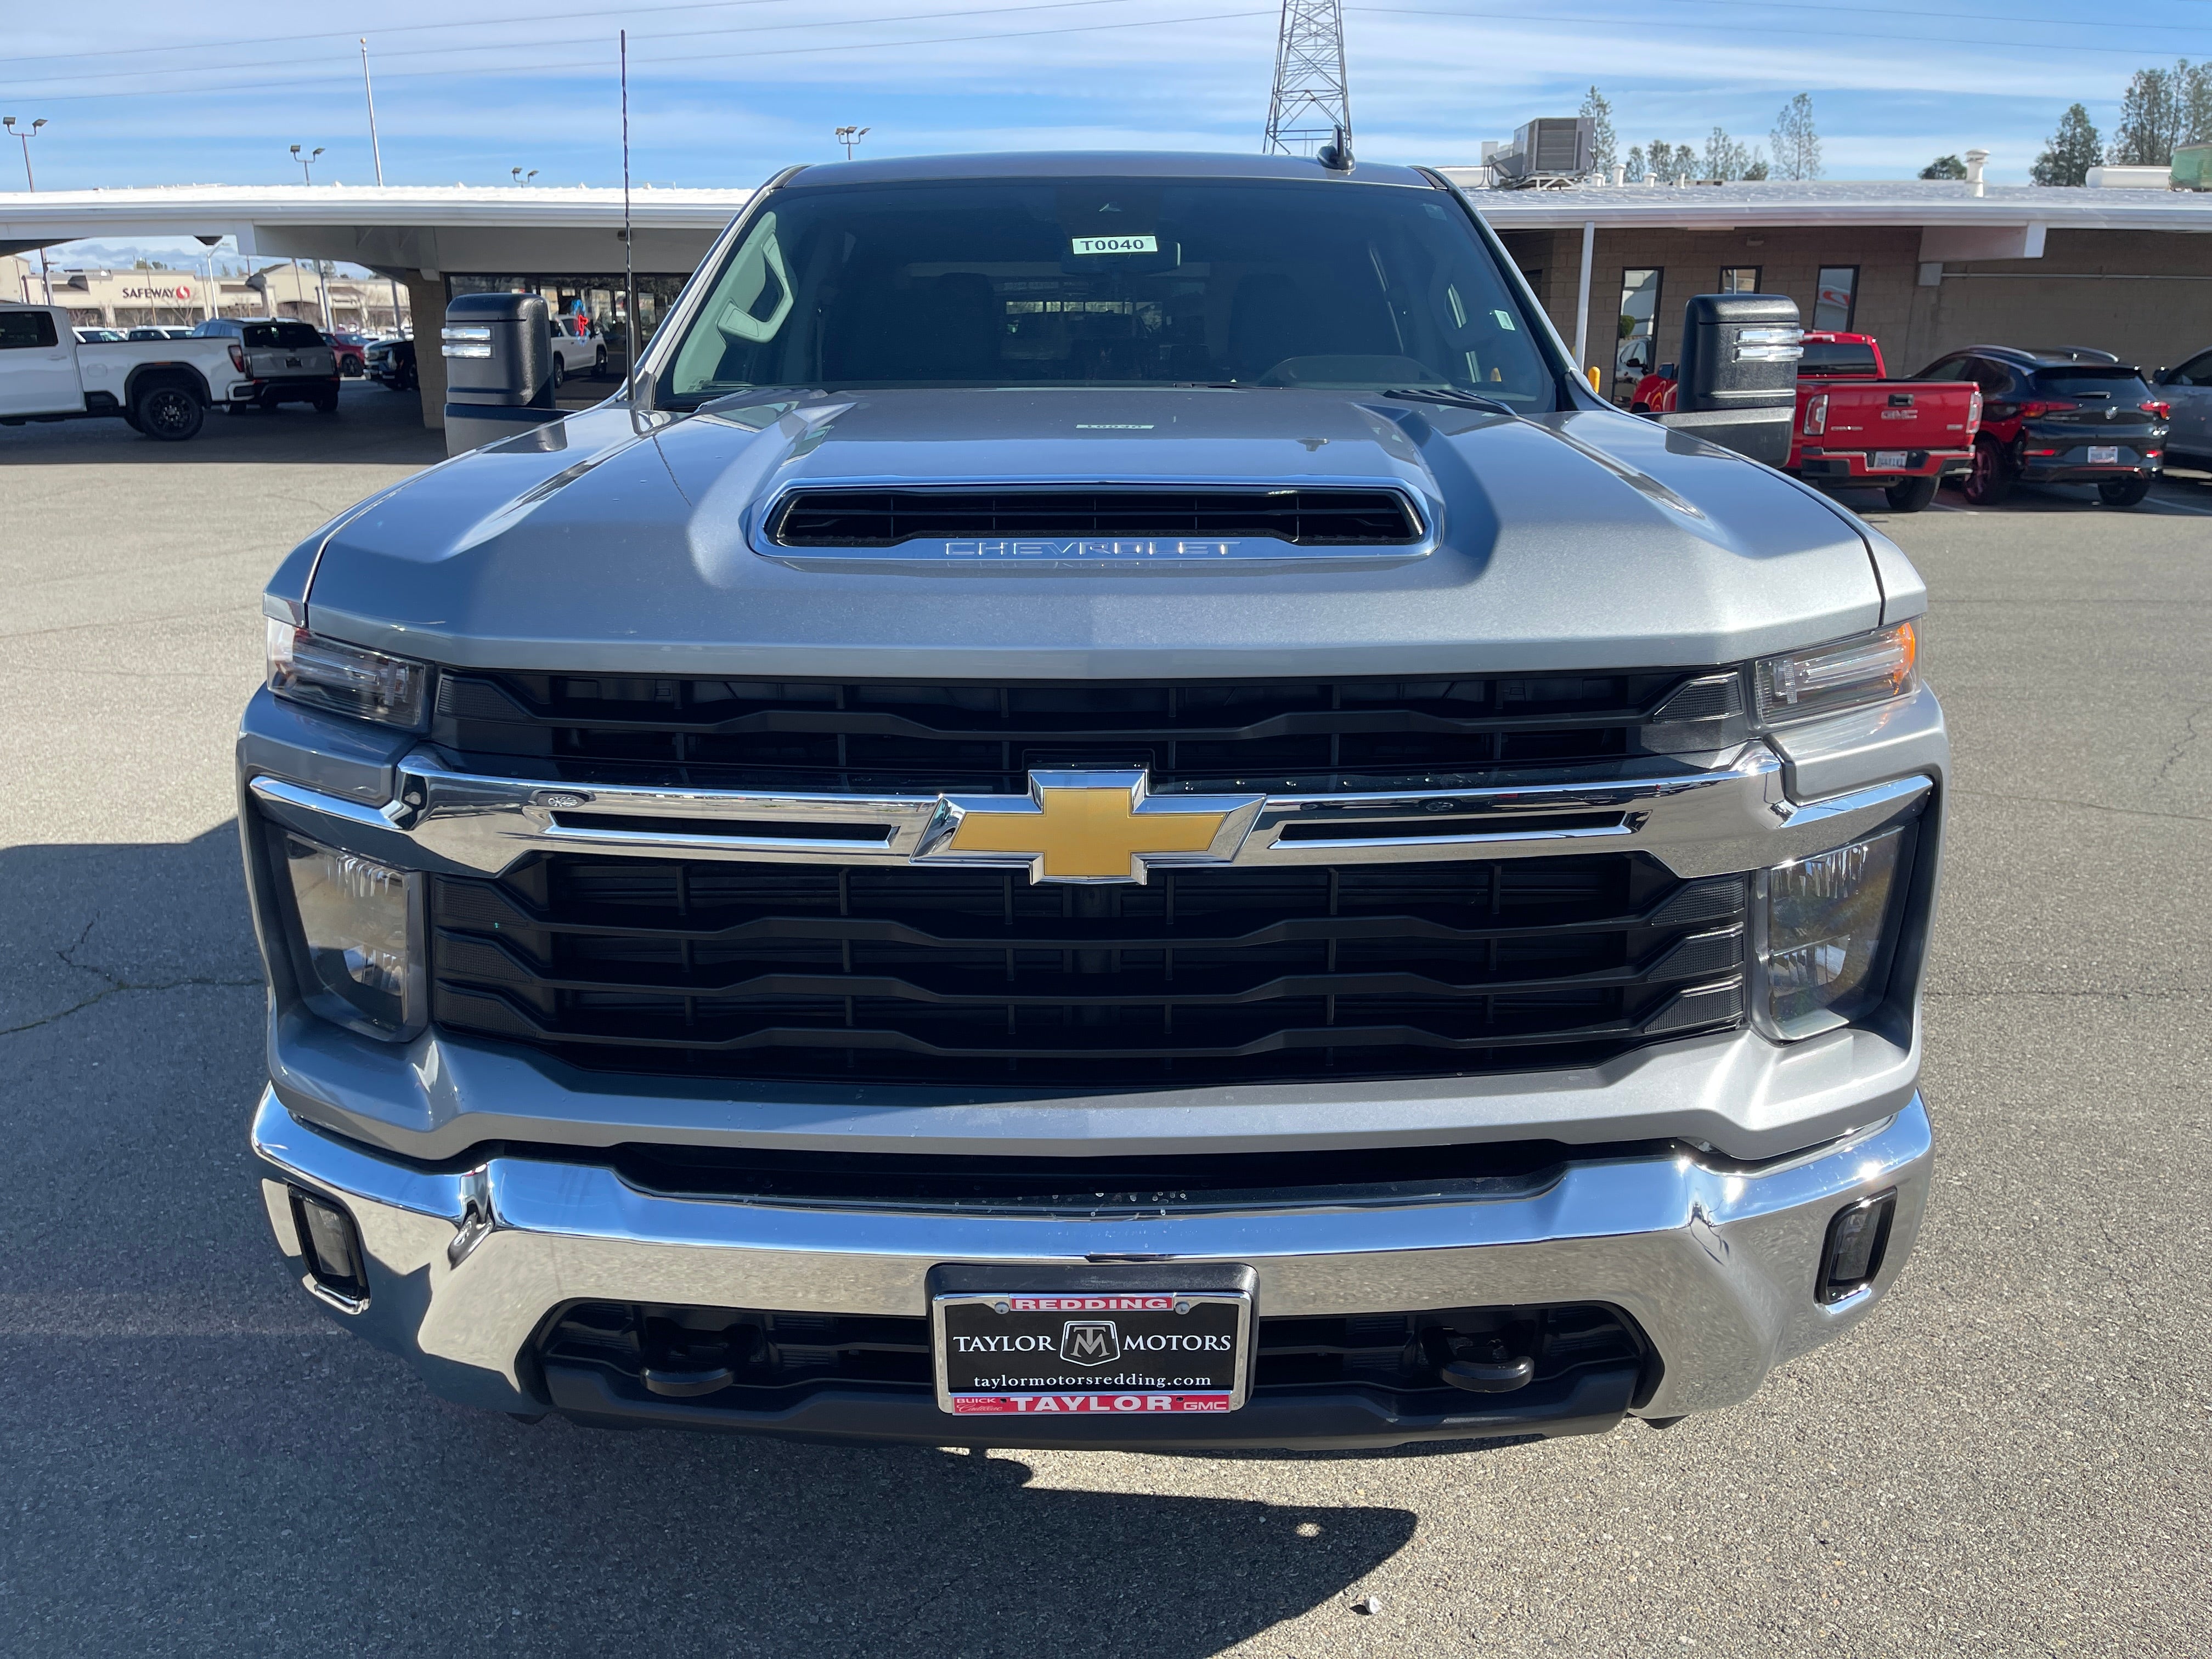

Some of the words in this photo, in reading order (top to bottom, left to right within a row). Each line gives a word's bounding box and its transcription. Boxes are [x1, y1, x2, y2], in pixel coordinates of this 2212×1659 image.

[1080, 239, 1144, 251] T0040
[122, 287, 175, 298] SAFEWAY
[1881, 410, 1918, 420] GMC
[945, 541, 1242, 555] CHEVROLET
[1015, 1299, 1168, 1310] REDDING
[953, 1335, 1057, 1353] TAYLOR
[1122, 1334, 1231, 1351] MOTORS
[974, 1373, 1211, 1390] taylormotorsredding.com
[1010, 1396, 1172, 1411] TAYLOR
[1183, 1401, 1227, 1410] GMC
